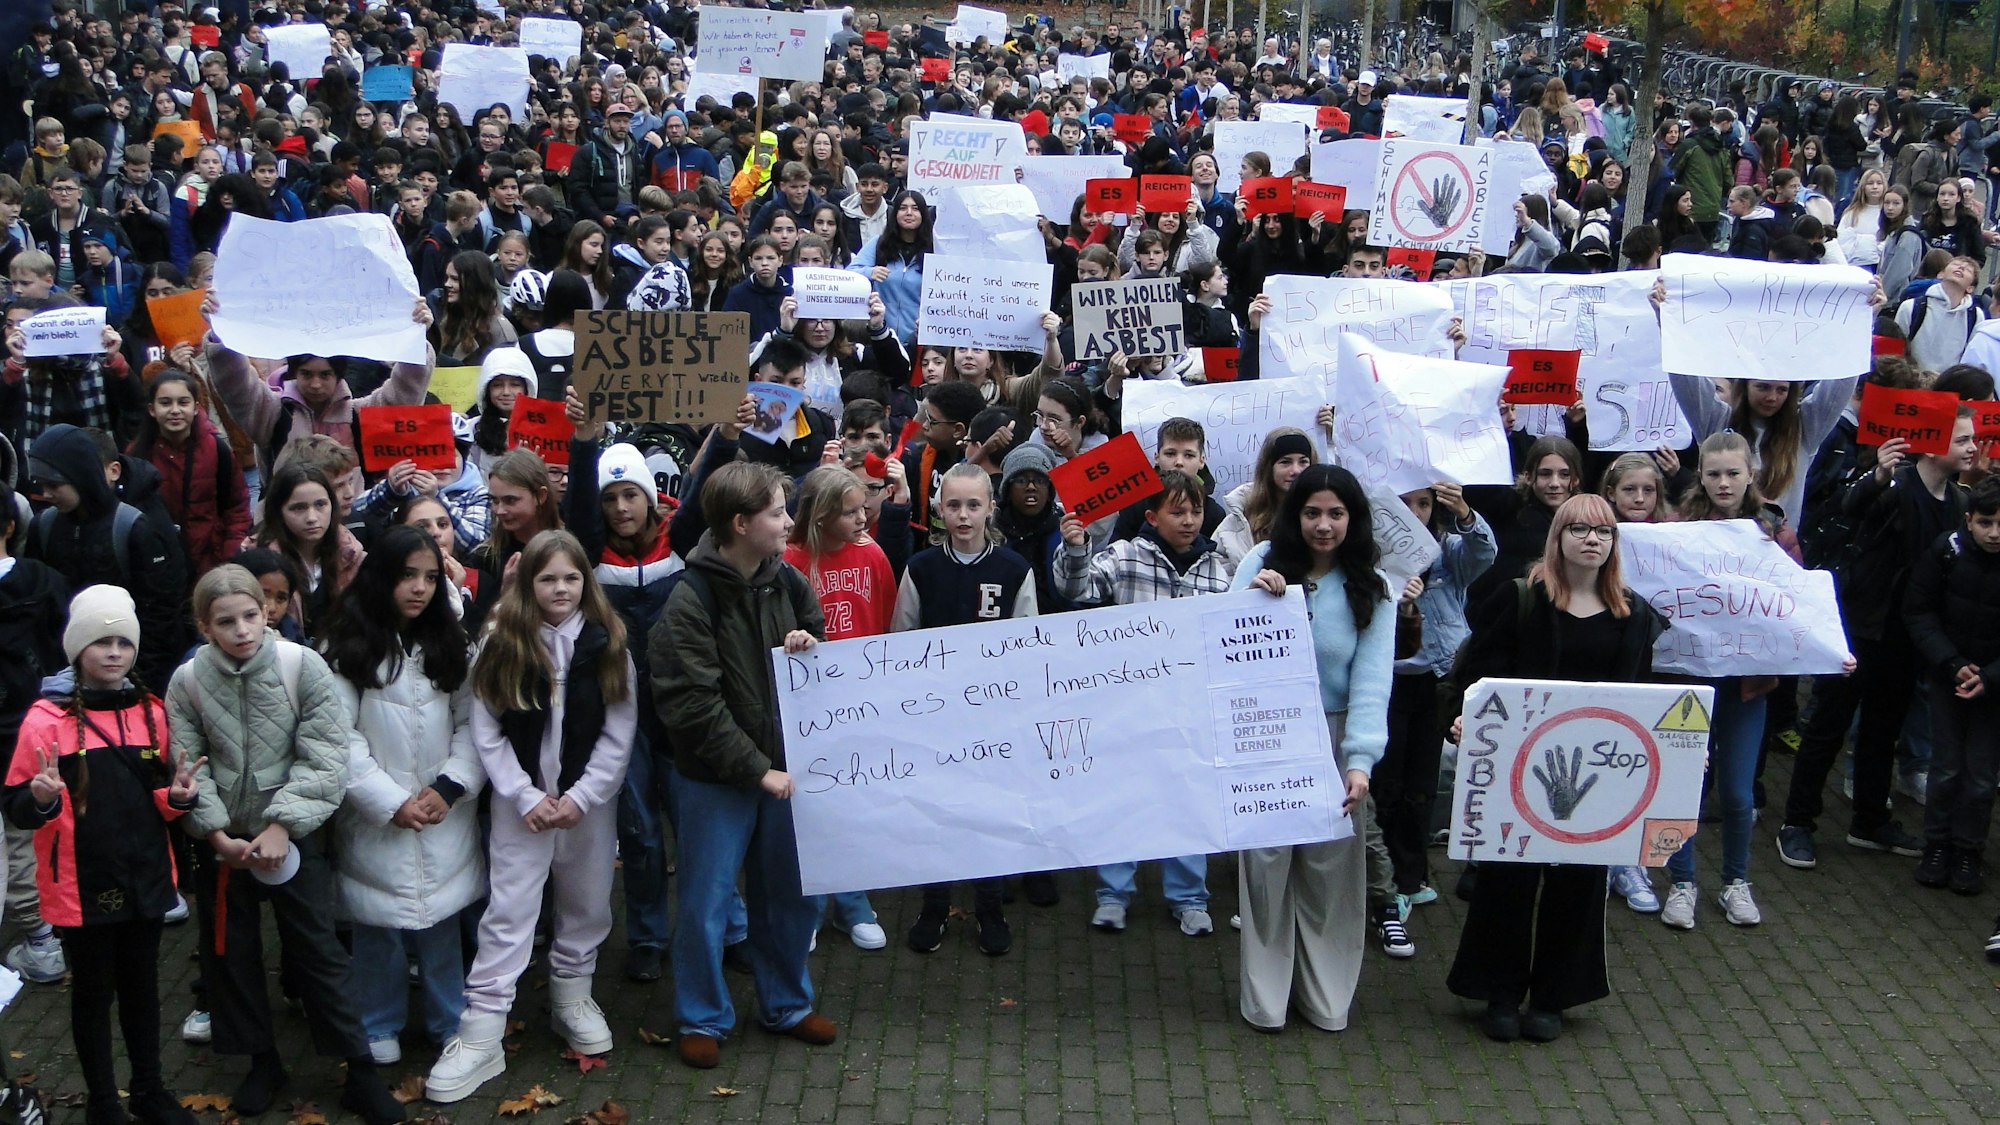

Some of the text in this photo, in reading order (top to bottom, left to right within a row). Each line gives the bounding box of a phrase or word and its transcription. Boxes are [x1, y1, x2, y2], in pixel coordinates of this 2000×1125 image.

[756, 32, 778, 40] Recht
[933, 128, 993, 148] RECHT
[944, 149, 979, 162] AUF
[914, 159, 1003, 180] GESUNDHEIT
[1101, 188, 1122, 199] ES
[1145, 182, 1187, 192] REICHT!
[1256, 187, 1277, 199] ES
[1300, 188, 1342, 201] REICHT!
[1373, 141, 1396, 241] SCHIMMEL
[805, 273, 855, 283] (AS)BESTIMMT
[934, 268, 1040, 290] Kinder sind unsere
[806, 295, 832, 303] UNSERE
[928, 288, 1039, 307] Zukunft, sie sind die
[1079, 282, 1182, 307] WIR WOLLEN
[1682, 272, 1868, 325] ES REICHT
[927, 305, 1015, 322] Gesellschaft von
[1285, 287, 1405, 323] ES GEHT
[30, 318, 96, 328] damit die Luft
[587, 311, 747, 339] SCHULE mit
[1106, 305, 1152, 330] KEIN
[32, 332, 49, 340] rein
[927, 325, 974, 338] morgen.
[1084, 324, 1182, 358] ASBEST
[581, 335, 721, 371] ASBEST
[1268, 331, 1308, 362] UM
[1533, 361, 1553, 372] ES
[1509, 382, 1573, 395] REICHT!
[589, 390, 705, 421] PEST !!!
[1206, 390, 1296, 428] GEHT
[1895, 403, 1919, 416] ES
[394, 420, 417, 433] ES
[526, 411, 546, 424] ES
[1982, 413, 2000, 425] ES
[1866, 421, 1941, 441] REICHT!
[372, 444, 447, 457] REICHT!
[1085, 461, 1110, 482] ES
[1073, 470, 1149, 517] REICHT!
[1630, 541, 1689, 576] WIR
[978, 583, 1002, 617] E
[1650, 584, 1796, 621] GESUND
[824, 600, 853, 634] 72
[1234, 614, 1273, 629] HMG
[1219, 628, 1296, 648] AS-BESTE
[1657, 630, 1779, 664] BLEIBEN
[787, 615, 1176, 693] Die Stadt würde handeln,
[1225, 645, 1290, 664] SCHULE
[798, 699, 880, 738] wenn
[900, 692, 946, 716] es
[963, 679, 1020, 706] eine
[1230, 696, 1258, 709] KEIN
[1232, 707, 1302, 724] (AS)BESTER
[1233, 723, 1287, 738] ORT ZUM
[1658, 732, 1701, 741] DANGER
[1234, 738, 1282, 752] LERNEN
[1667, 741, 1706, 749] ASBEST
[804, 755, 917, 795] Schule
[936, 738, 1014, 767] wäre
[1587, 740, 1649, 778] Stop
[1459, 690, 1510, 859] ASBEST
[1231, 775, 1315, 794] Wissen statt
[1233, 799, 1311, 816] (as)Bestien.
